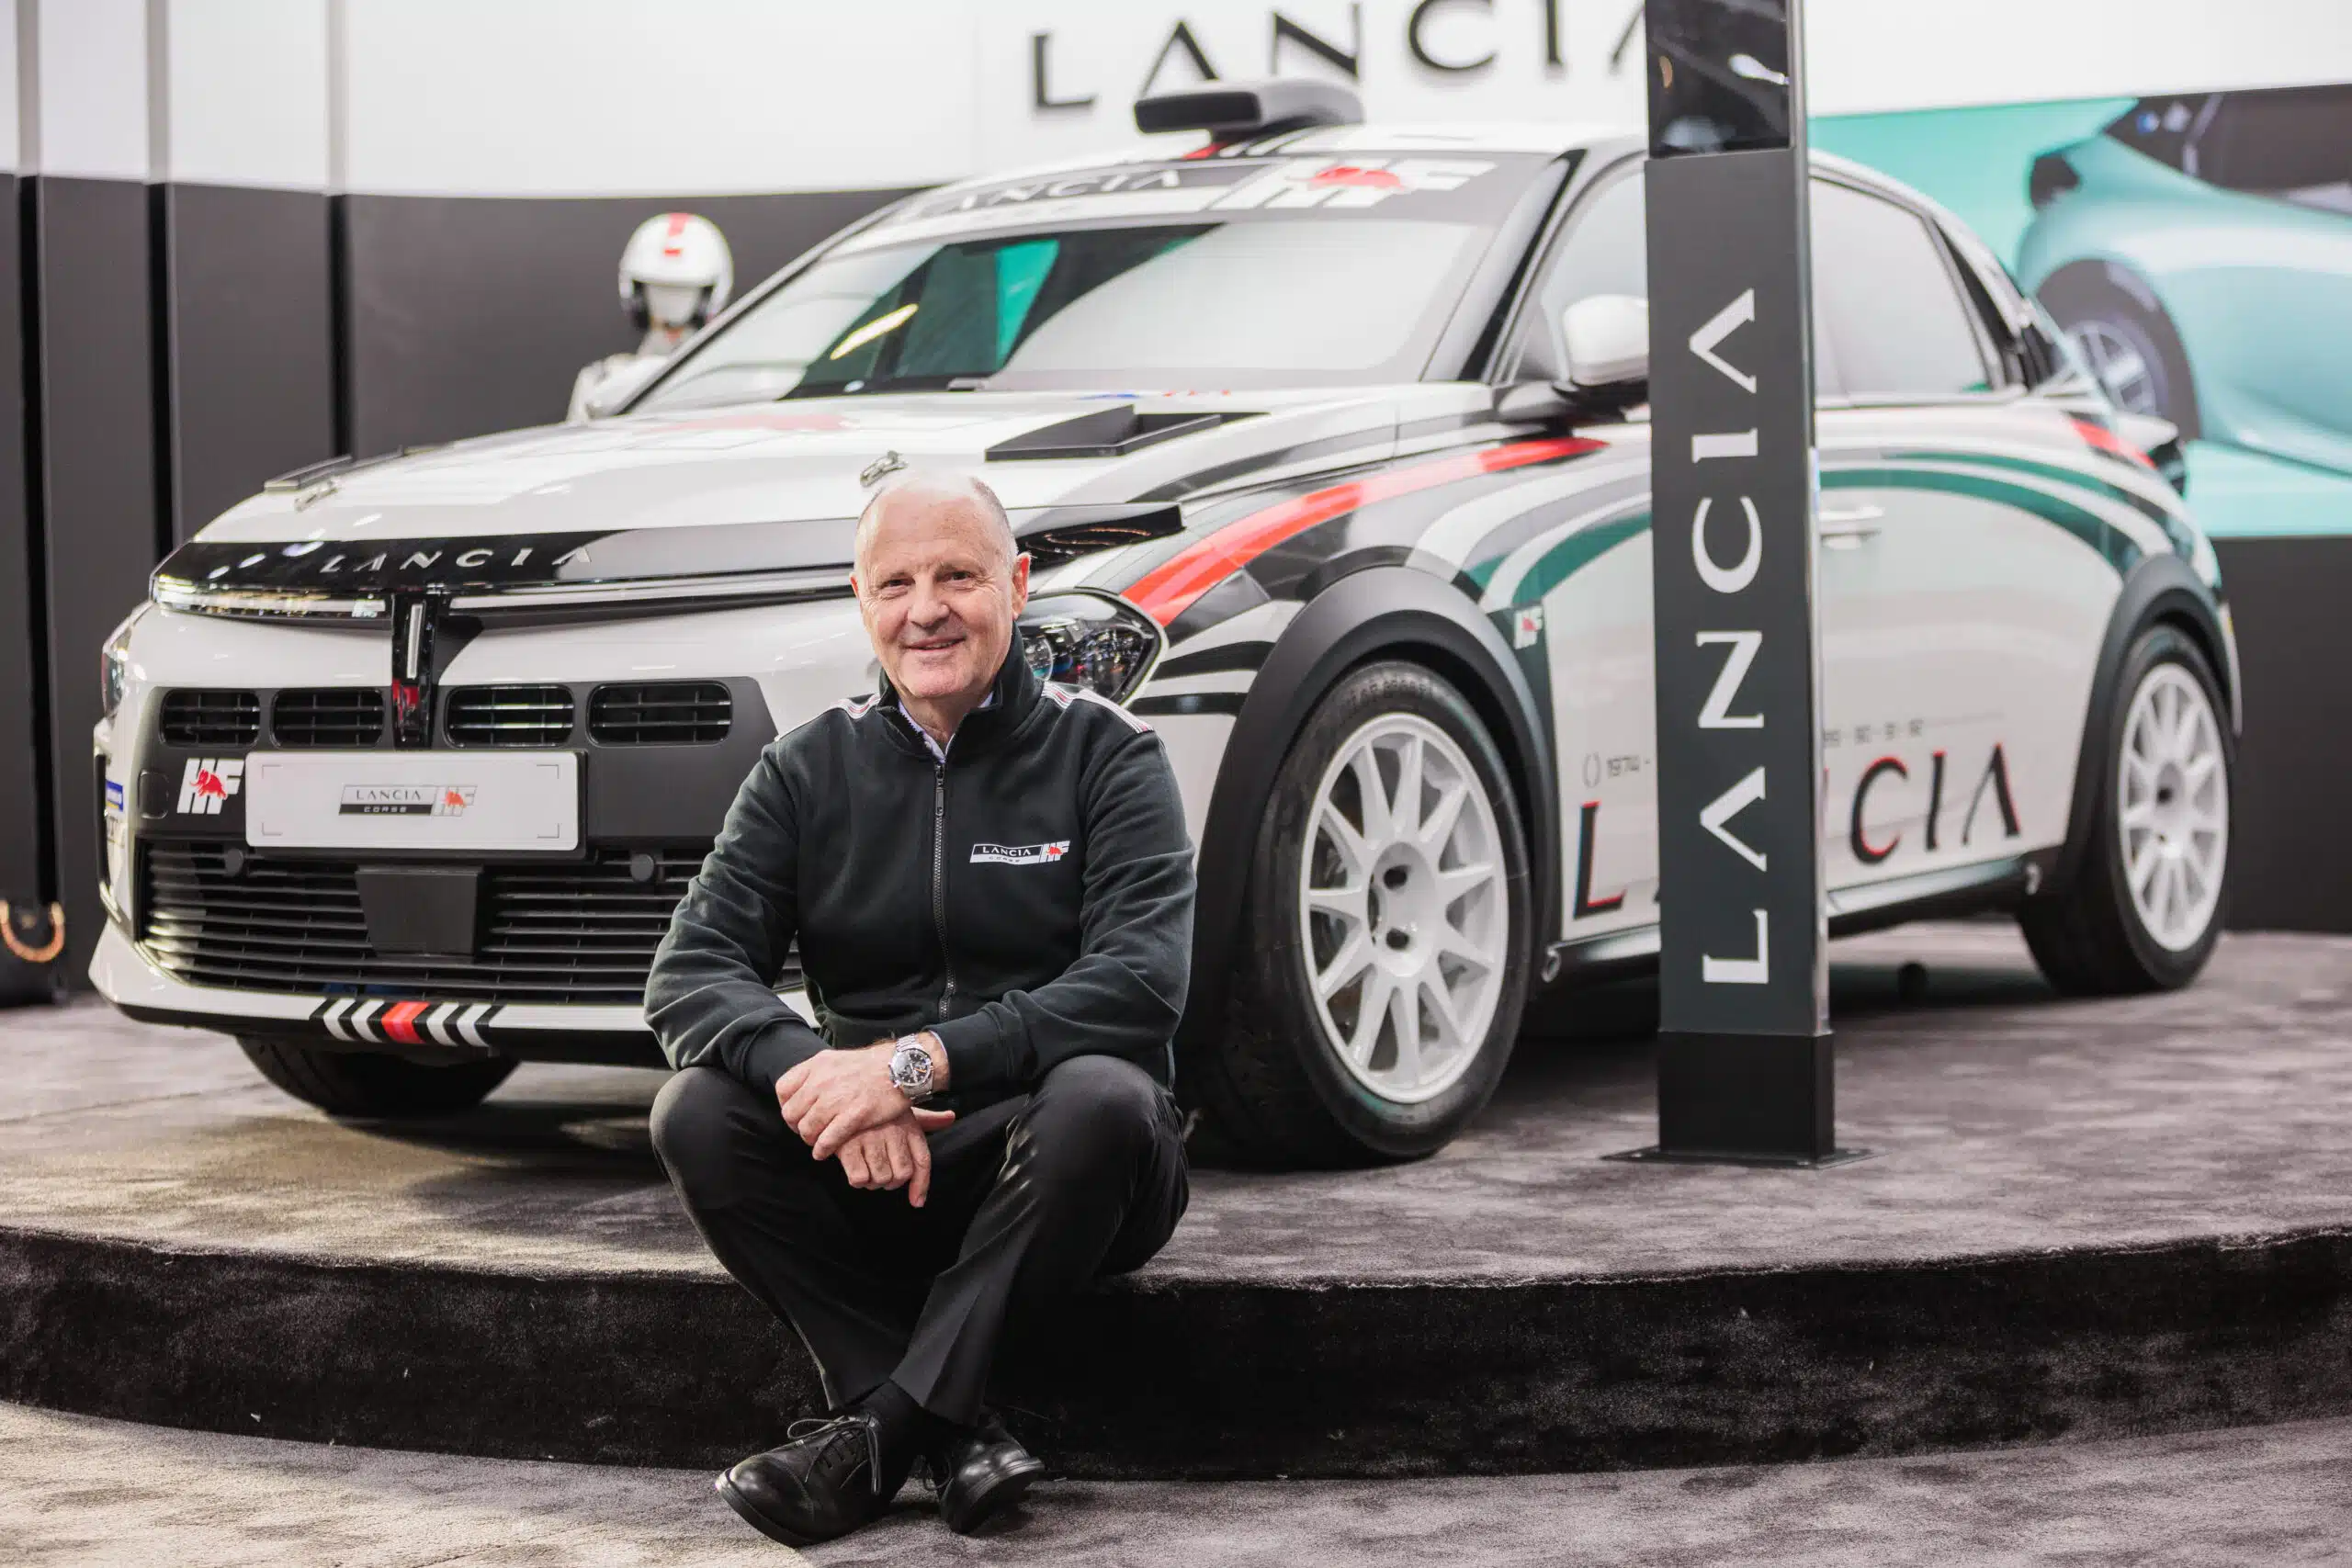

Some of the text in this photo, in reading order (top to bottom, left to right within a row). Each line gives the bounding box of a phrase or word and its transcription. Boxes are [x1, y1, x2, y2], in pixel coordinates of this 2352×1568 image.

[320, 547, 592, 573] LANCIA
[1689, 288, 1770, 985] LANCIA
[356, 789, 422, 801] LANCIA
[982, 845, 1032, 857] LANCIA
